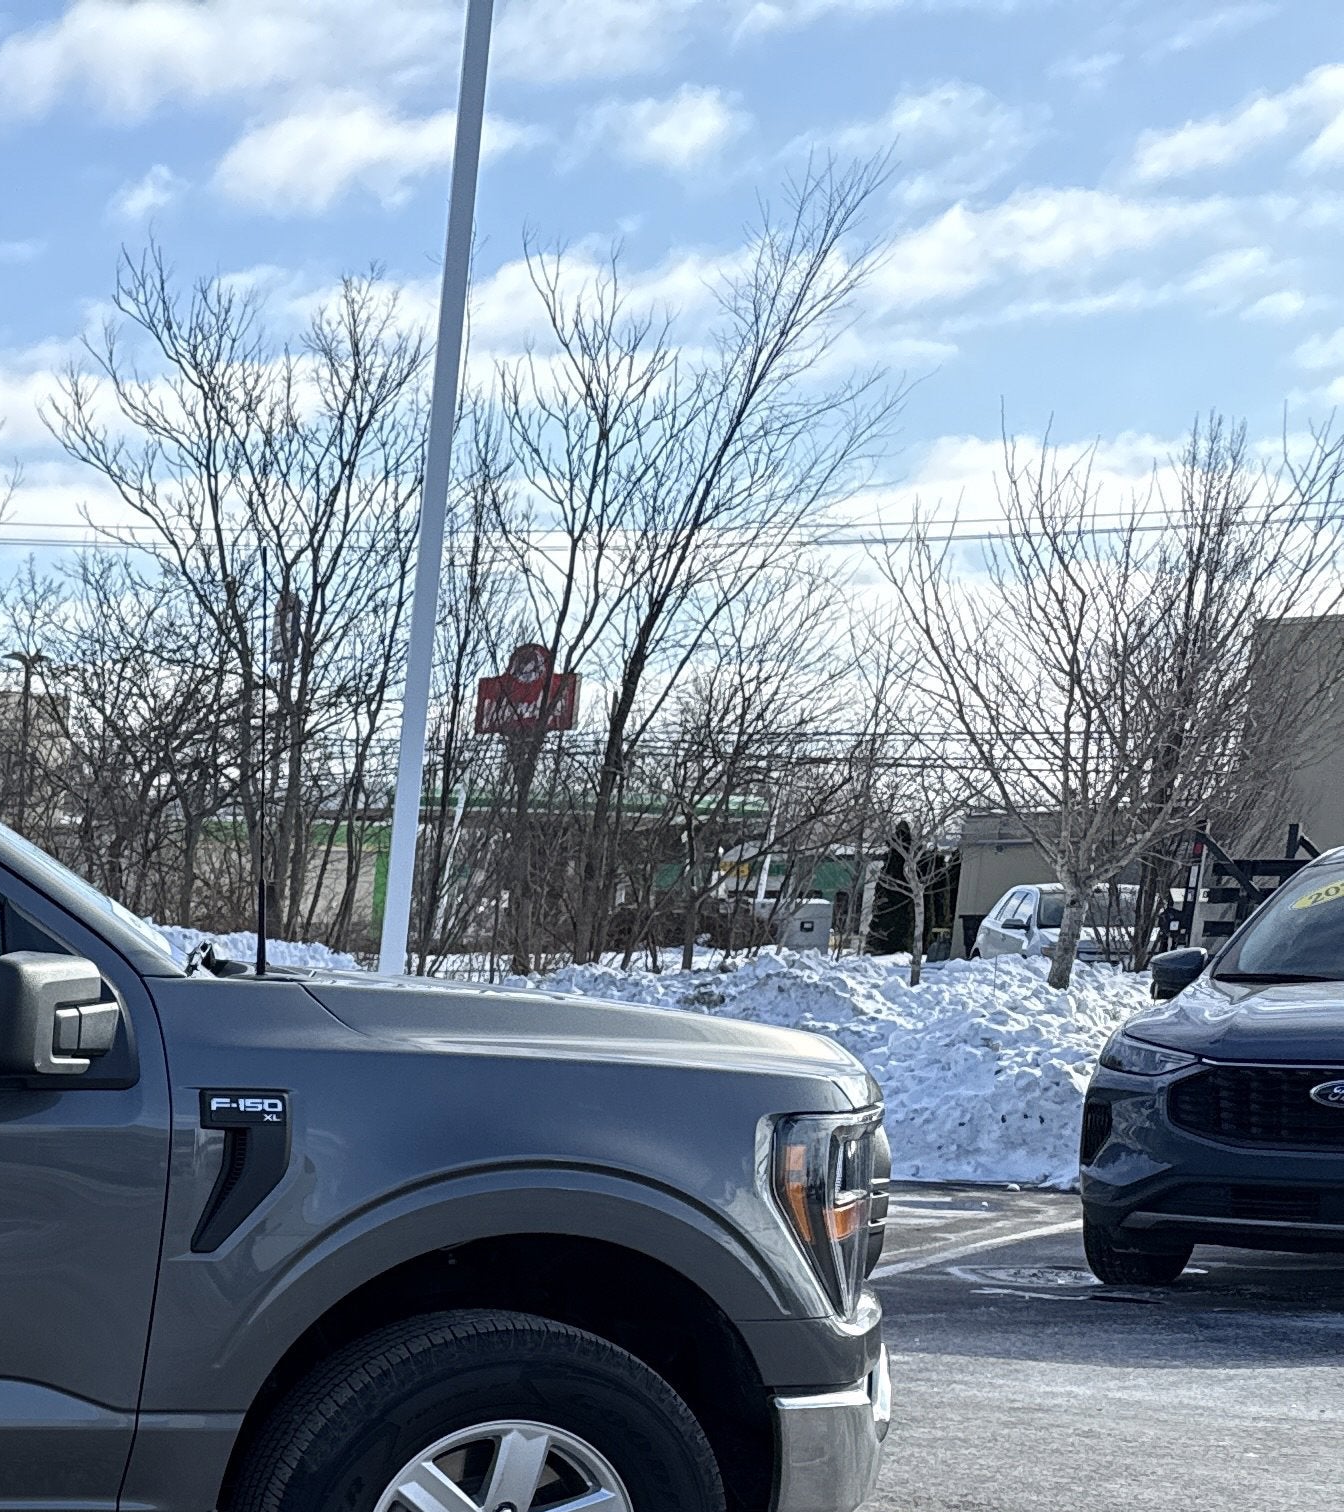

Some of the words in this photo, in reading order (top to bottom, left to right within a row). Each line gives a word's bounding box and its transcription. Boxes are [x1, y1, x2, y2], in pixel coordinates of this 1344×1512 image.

[1308, 880, 1344, 903] 20
[210, 1097, 283, 1112] F-150
[262, 1113, 282, 1122] XL
